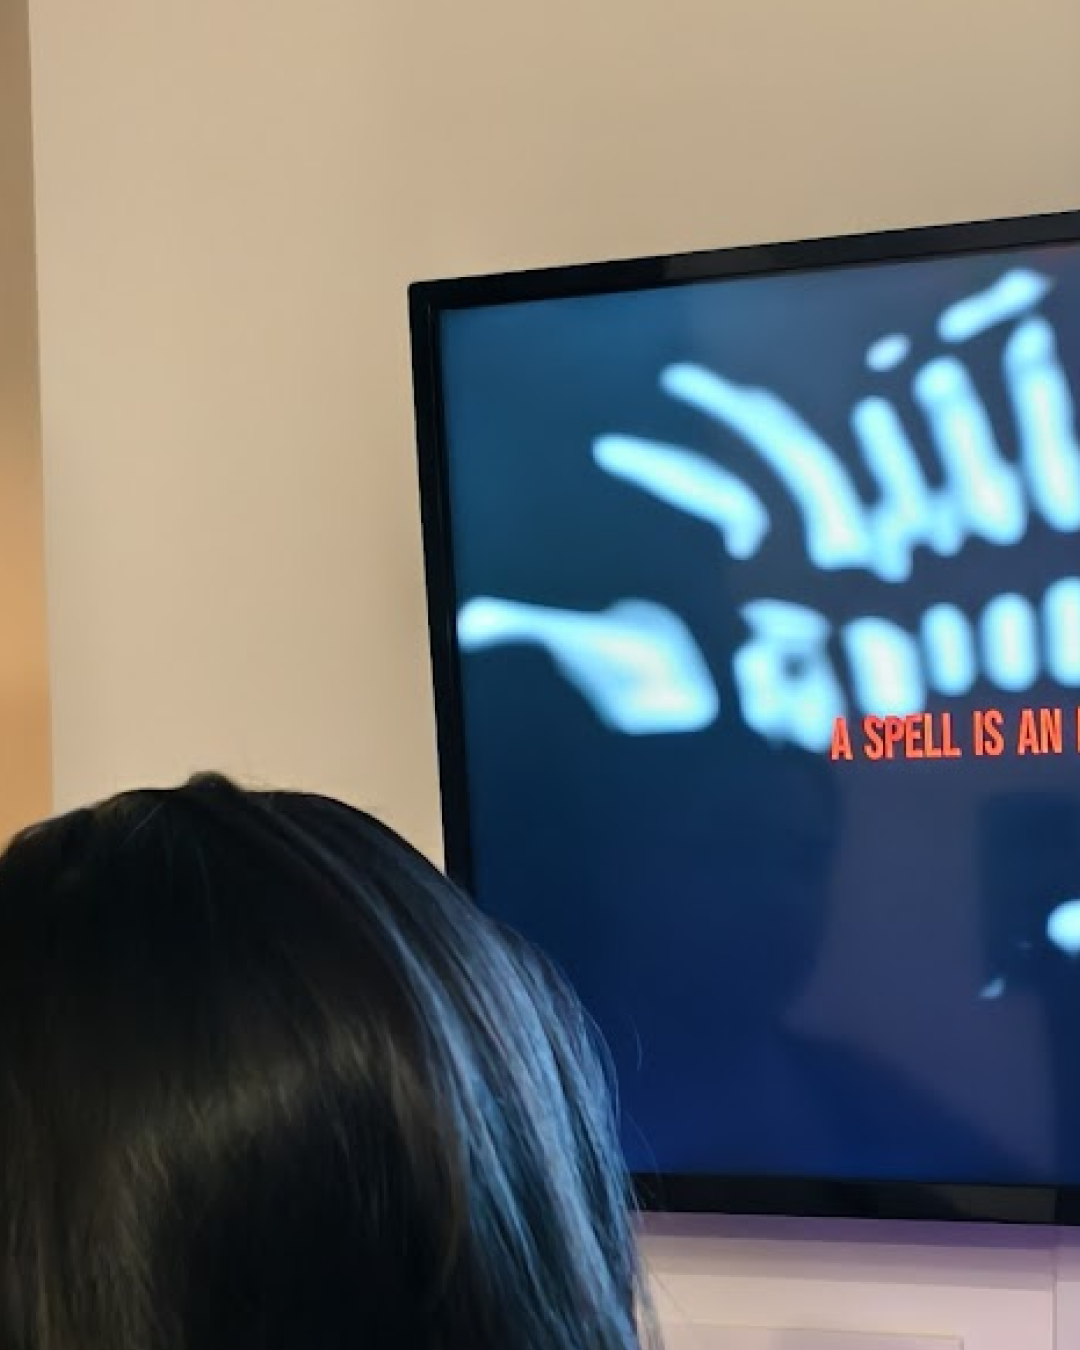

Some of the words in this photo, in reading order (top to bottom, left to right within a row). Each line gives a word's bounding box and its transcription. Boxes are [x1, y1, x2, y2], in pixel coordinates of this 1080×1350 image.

[830, 717, 853, 760] A
[863, 712, 962, 760] SPELL
[973, 709, 1004, 755] IS
[1017, 708, 1062, 755] AN
